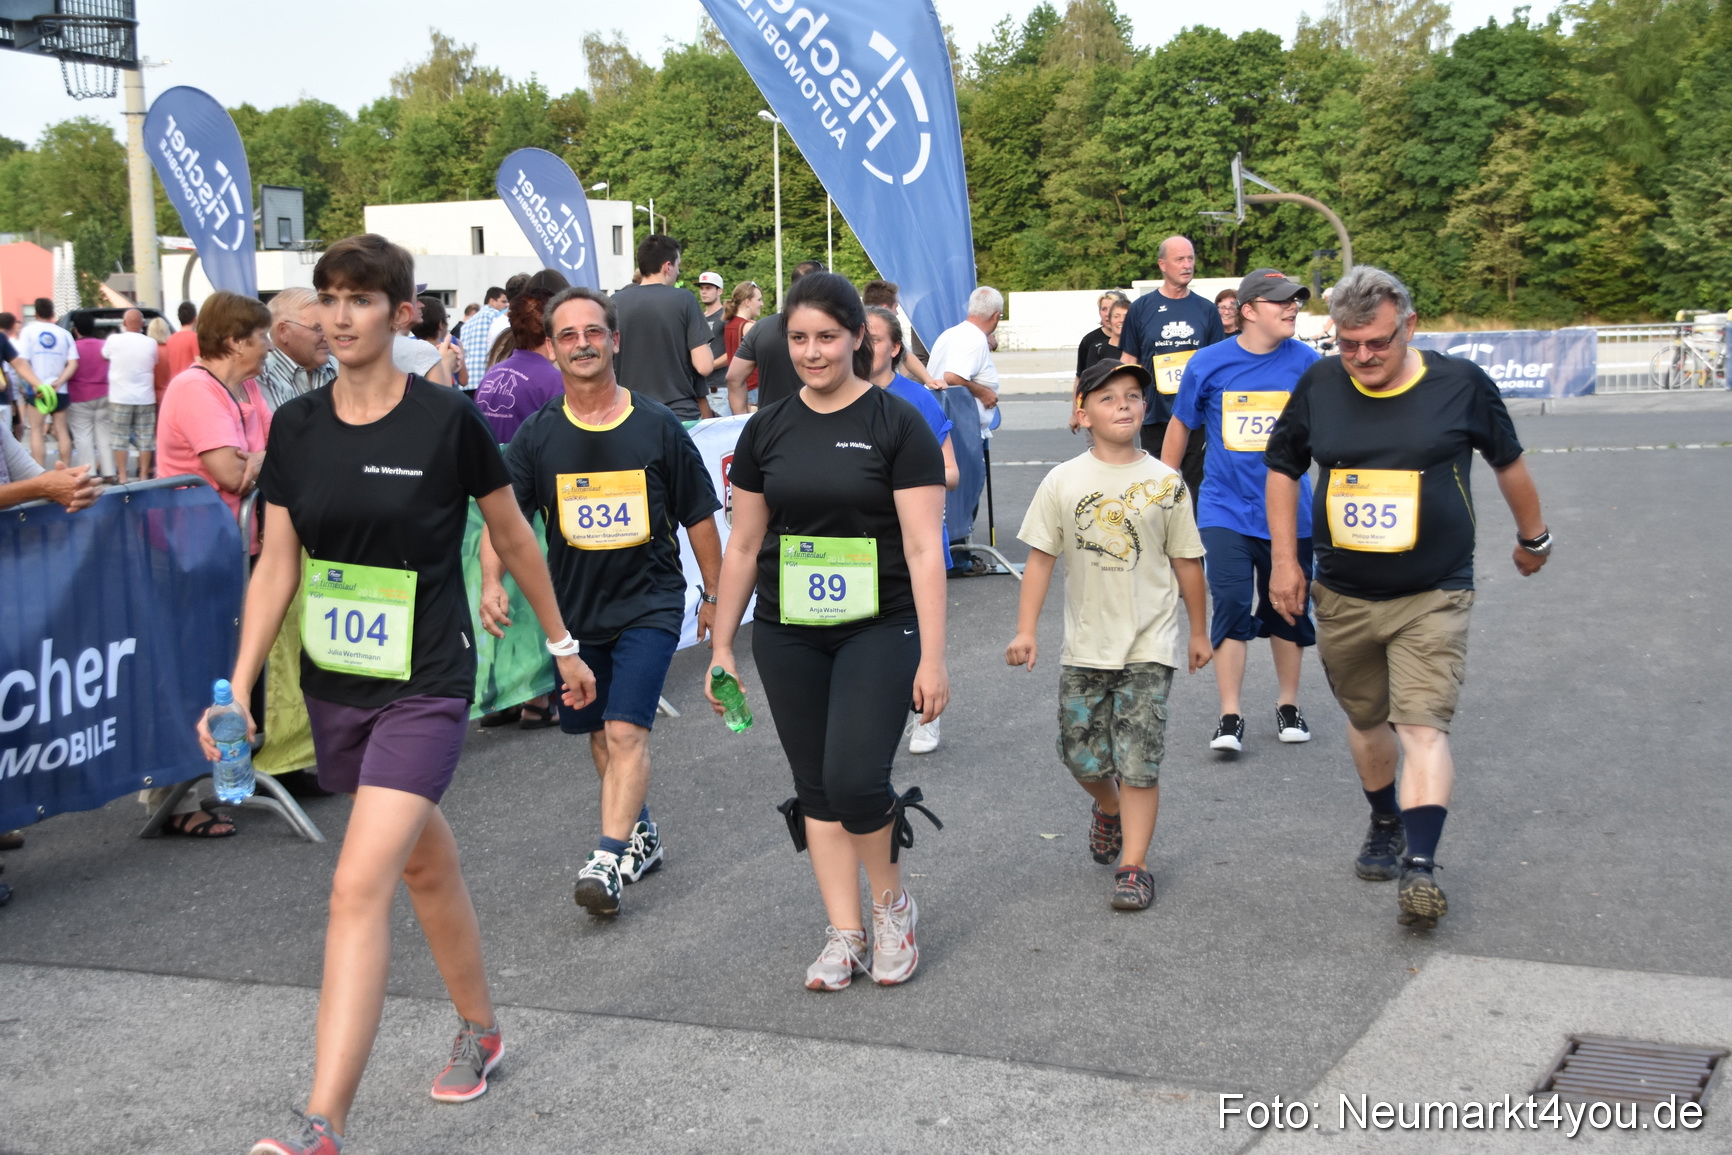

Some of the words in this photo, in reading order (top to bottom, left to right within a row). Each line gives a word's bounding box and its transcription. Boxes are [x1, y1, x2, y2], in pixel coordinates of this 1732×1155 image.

[1237, 416, 1279, 434] 752
[835, 441, 848, 449] Anja
[850, 441, 872, 450] Walther
[364, 465, 379, 473] Julia
[381, 466, 423, 476] Werthmann
[577, 502, 631, 529] 834
[1343, 502, 1397, 529] 835
[320, 579, 358, 592] firmenlauf
[808, 573, 847, 602] 89
[324, 606, 389, 647] 104
[327, 648, 343, 657] Julia
[343, 650, 381, 661] Werthmann
